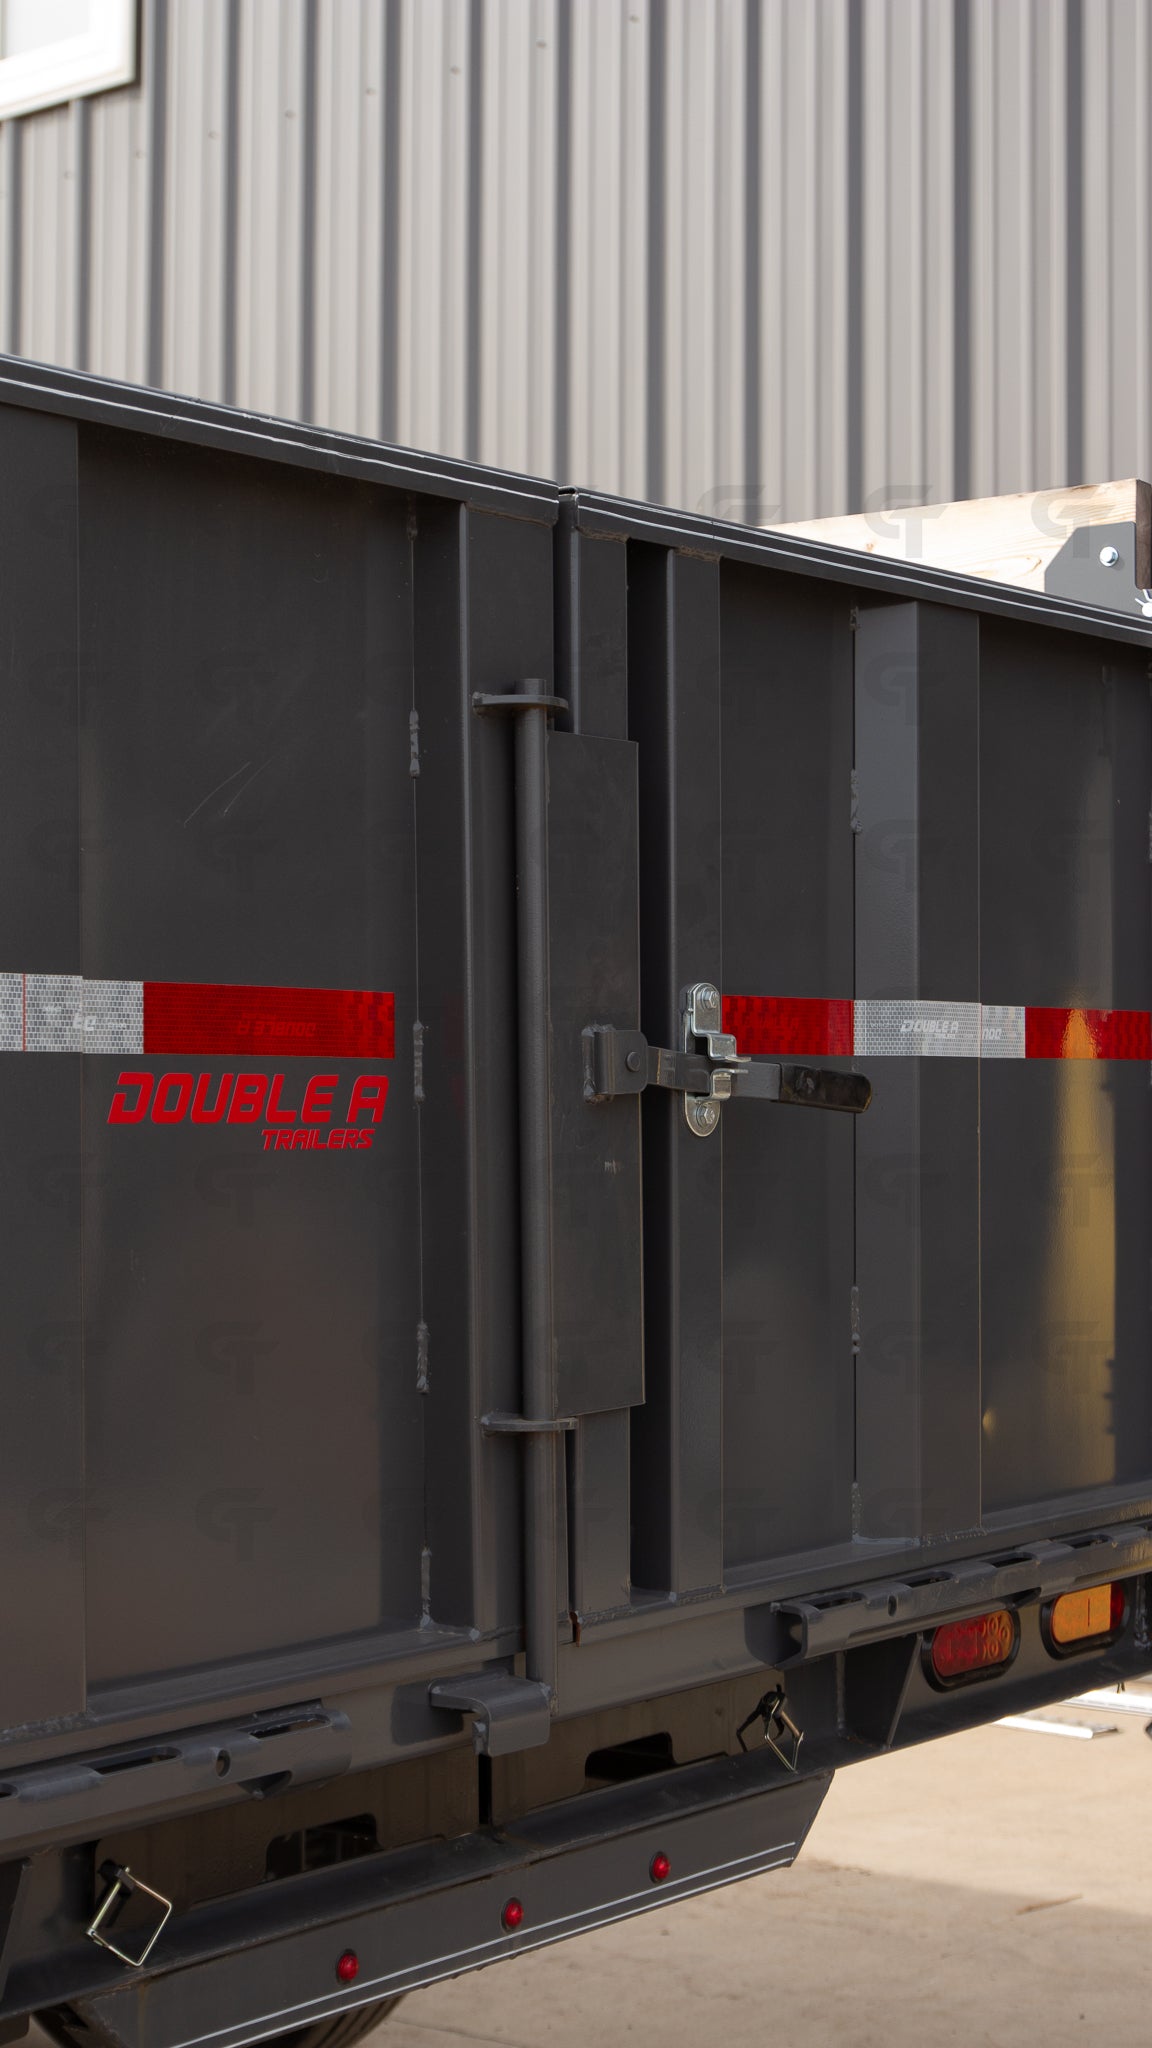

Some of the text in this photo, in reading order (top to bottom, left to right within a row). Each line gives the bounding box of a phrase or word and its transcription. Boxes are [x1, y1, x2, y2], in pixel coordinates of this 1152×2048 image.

[900, 1019, 950, 1033] DOUBLE
[107, 1071, 390, 1125] DOUBLE A
[261, 1128, 375, 1151] TRAILERS
